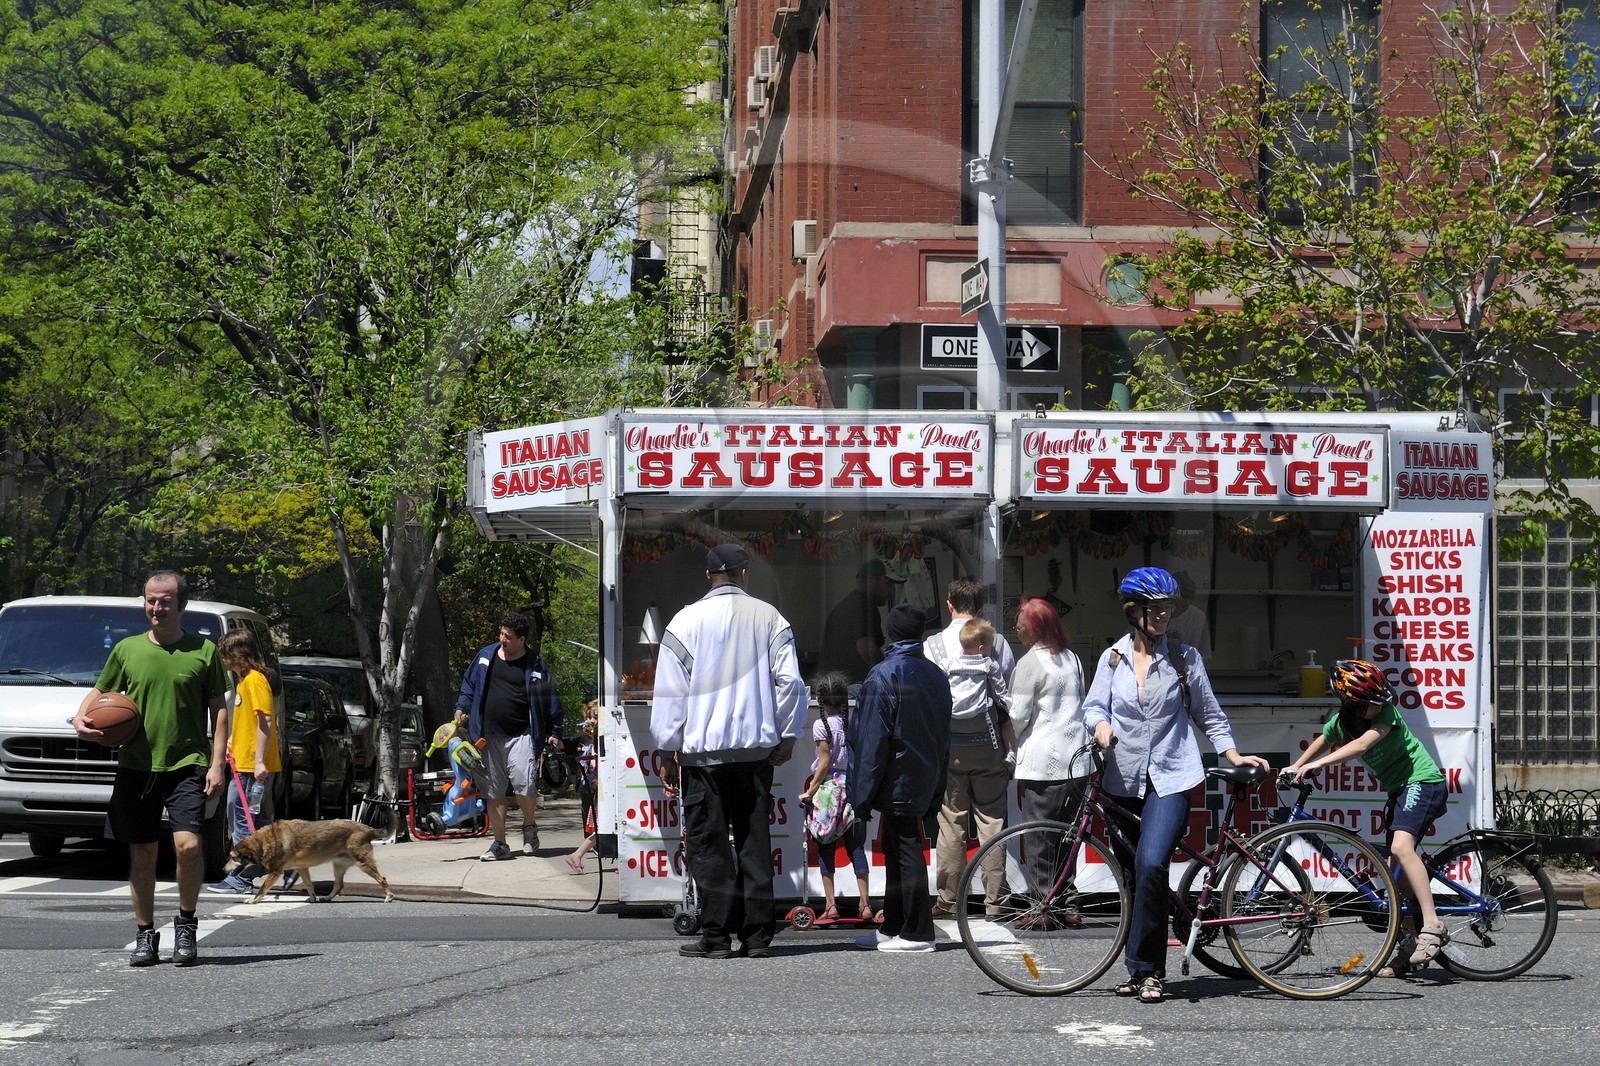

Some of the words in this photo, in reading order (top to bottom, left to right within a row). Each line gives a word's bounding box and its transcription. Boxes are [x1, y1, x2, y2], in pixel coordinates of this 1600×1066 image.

[943, 339, 978, 356] ONE
[500, 429, 590, 468] ITALIAN
[625, 422, 712, 452] Charlie's
[725, 425, 901, 447] ITALIAN
[920, 423, 982, 452] Paul's
[1024, 428, 1109, 458] Charlie's
[1121, 430, 1298, 454] ITALIAN
[1312, 432, 1375, 460] Paul's
[1403, 441, 1480, 470] ITALIAN
[491, 458, 604, 499] SAUSAGE
[637, 452, 973, 488] SAUSAGE
[1034, 457, 1369, 497] SAUSAGE
[1396, 472, 1490, 500] SAUSAGE
[1371, 528, 1476, 549] MOZZARELLA
[1390, 550, 1462, 570] STICKS
[1377, 574, 1463, 594] SHISH
[1372, 597, 1471, 617] KABOB
[1373, 621, 1470, 640] CHEESE
[1373, 643, 1475, 662] STEAKS
[1383, 667, 1466, 687] CORN
[639, 798, 679, 830] SHIS
[640, 850, 668, 878] ICE
